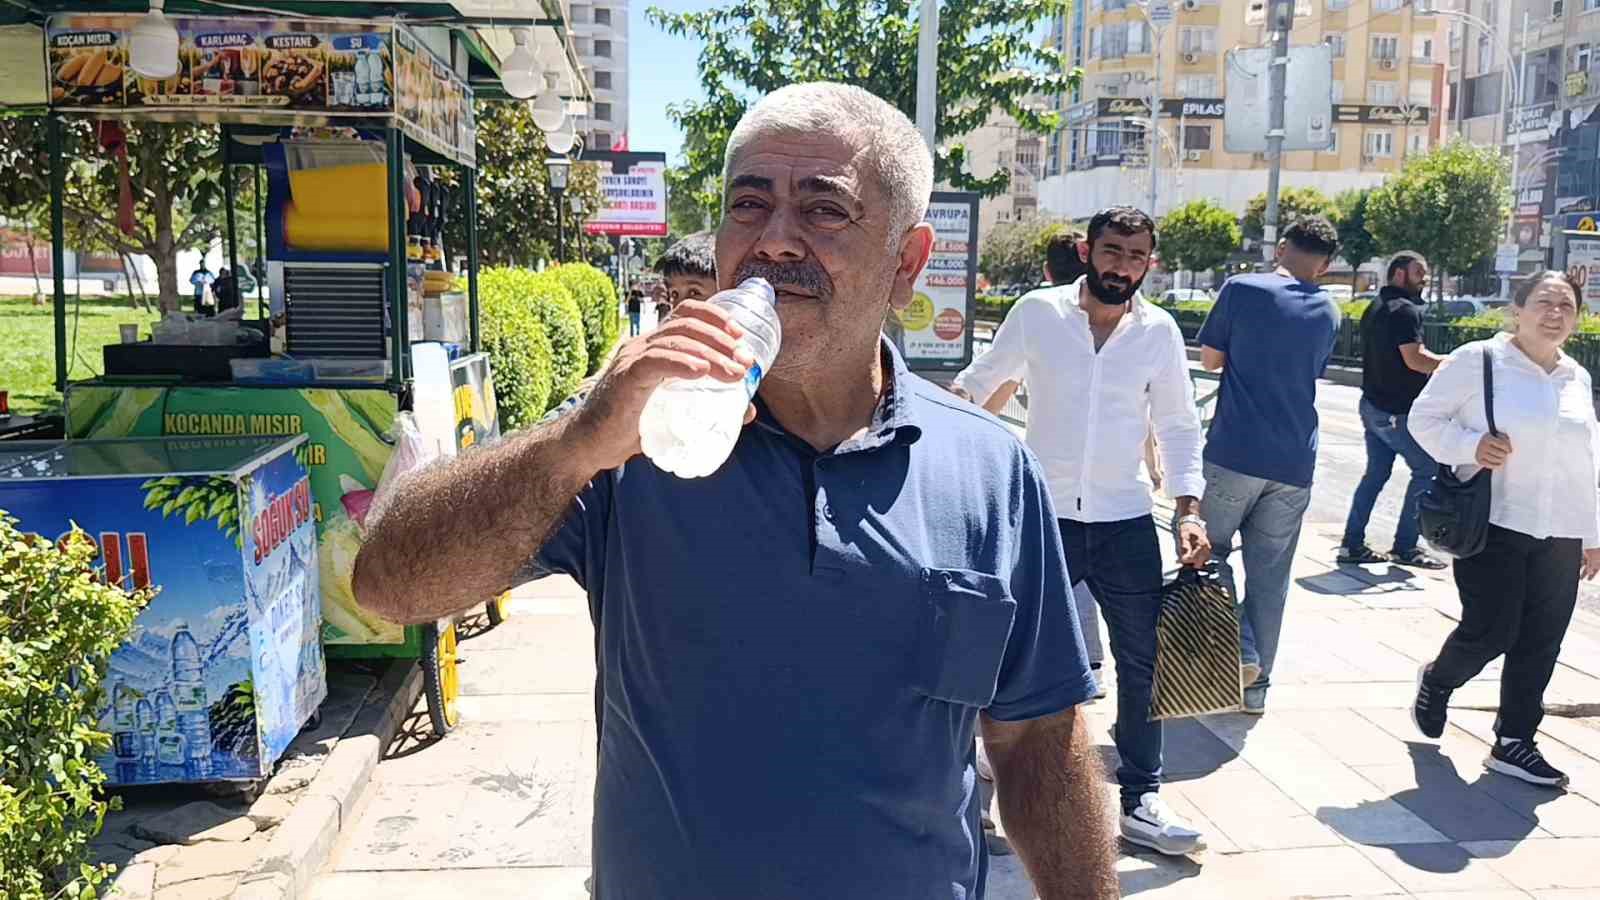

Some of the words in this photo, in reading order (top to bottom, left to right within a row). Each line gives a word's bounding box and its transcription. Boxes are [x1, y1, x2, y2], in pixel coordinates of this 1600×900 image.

[272, 36, 313, 48] KESTANE
[350, 37, 363, 48] SU
[925, 208, 968, 219] AVRUPA
[250, 413, 302, 434] MISIR
